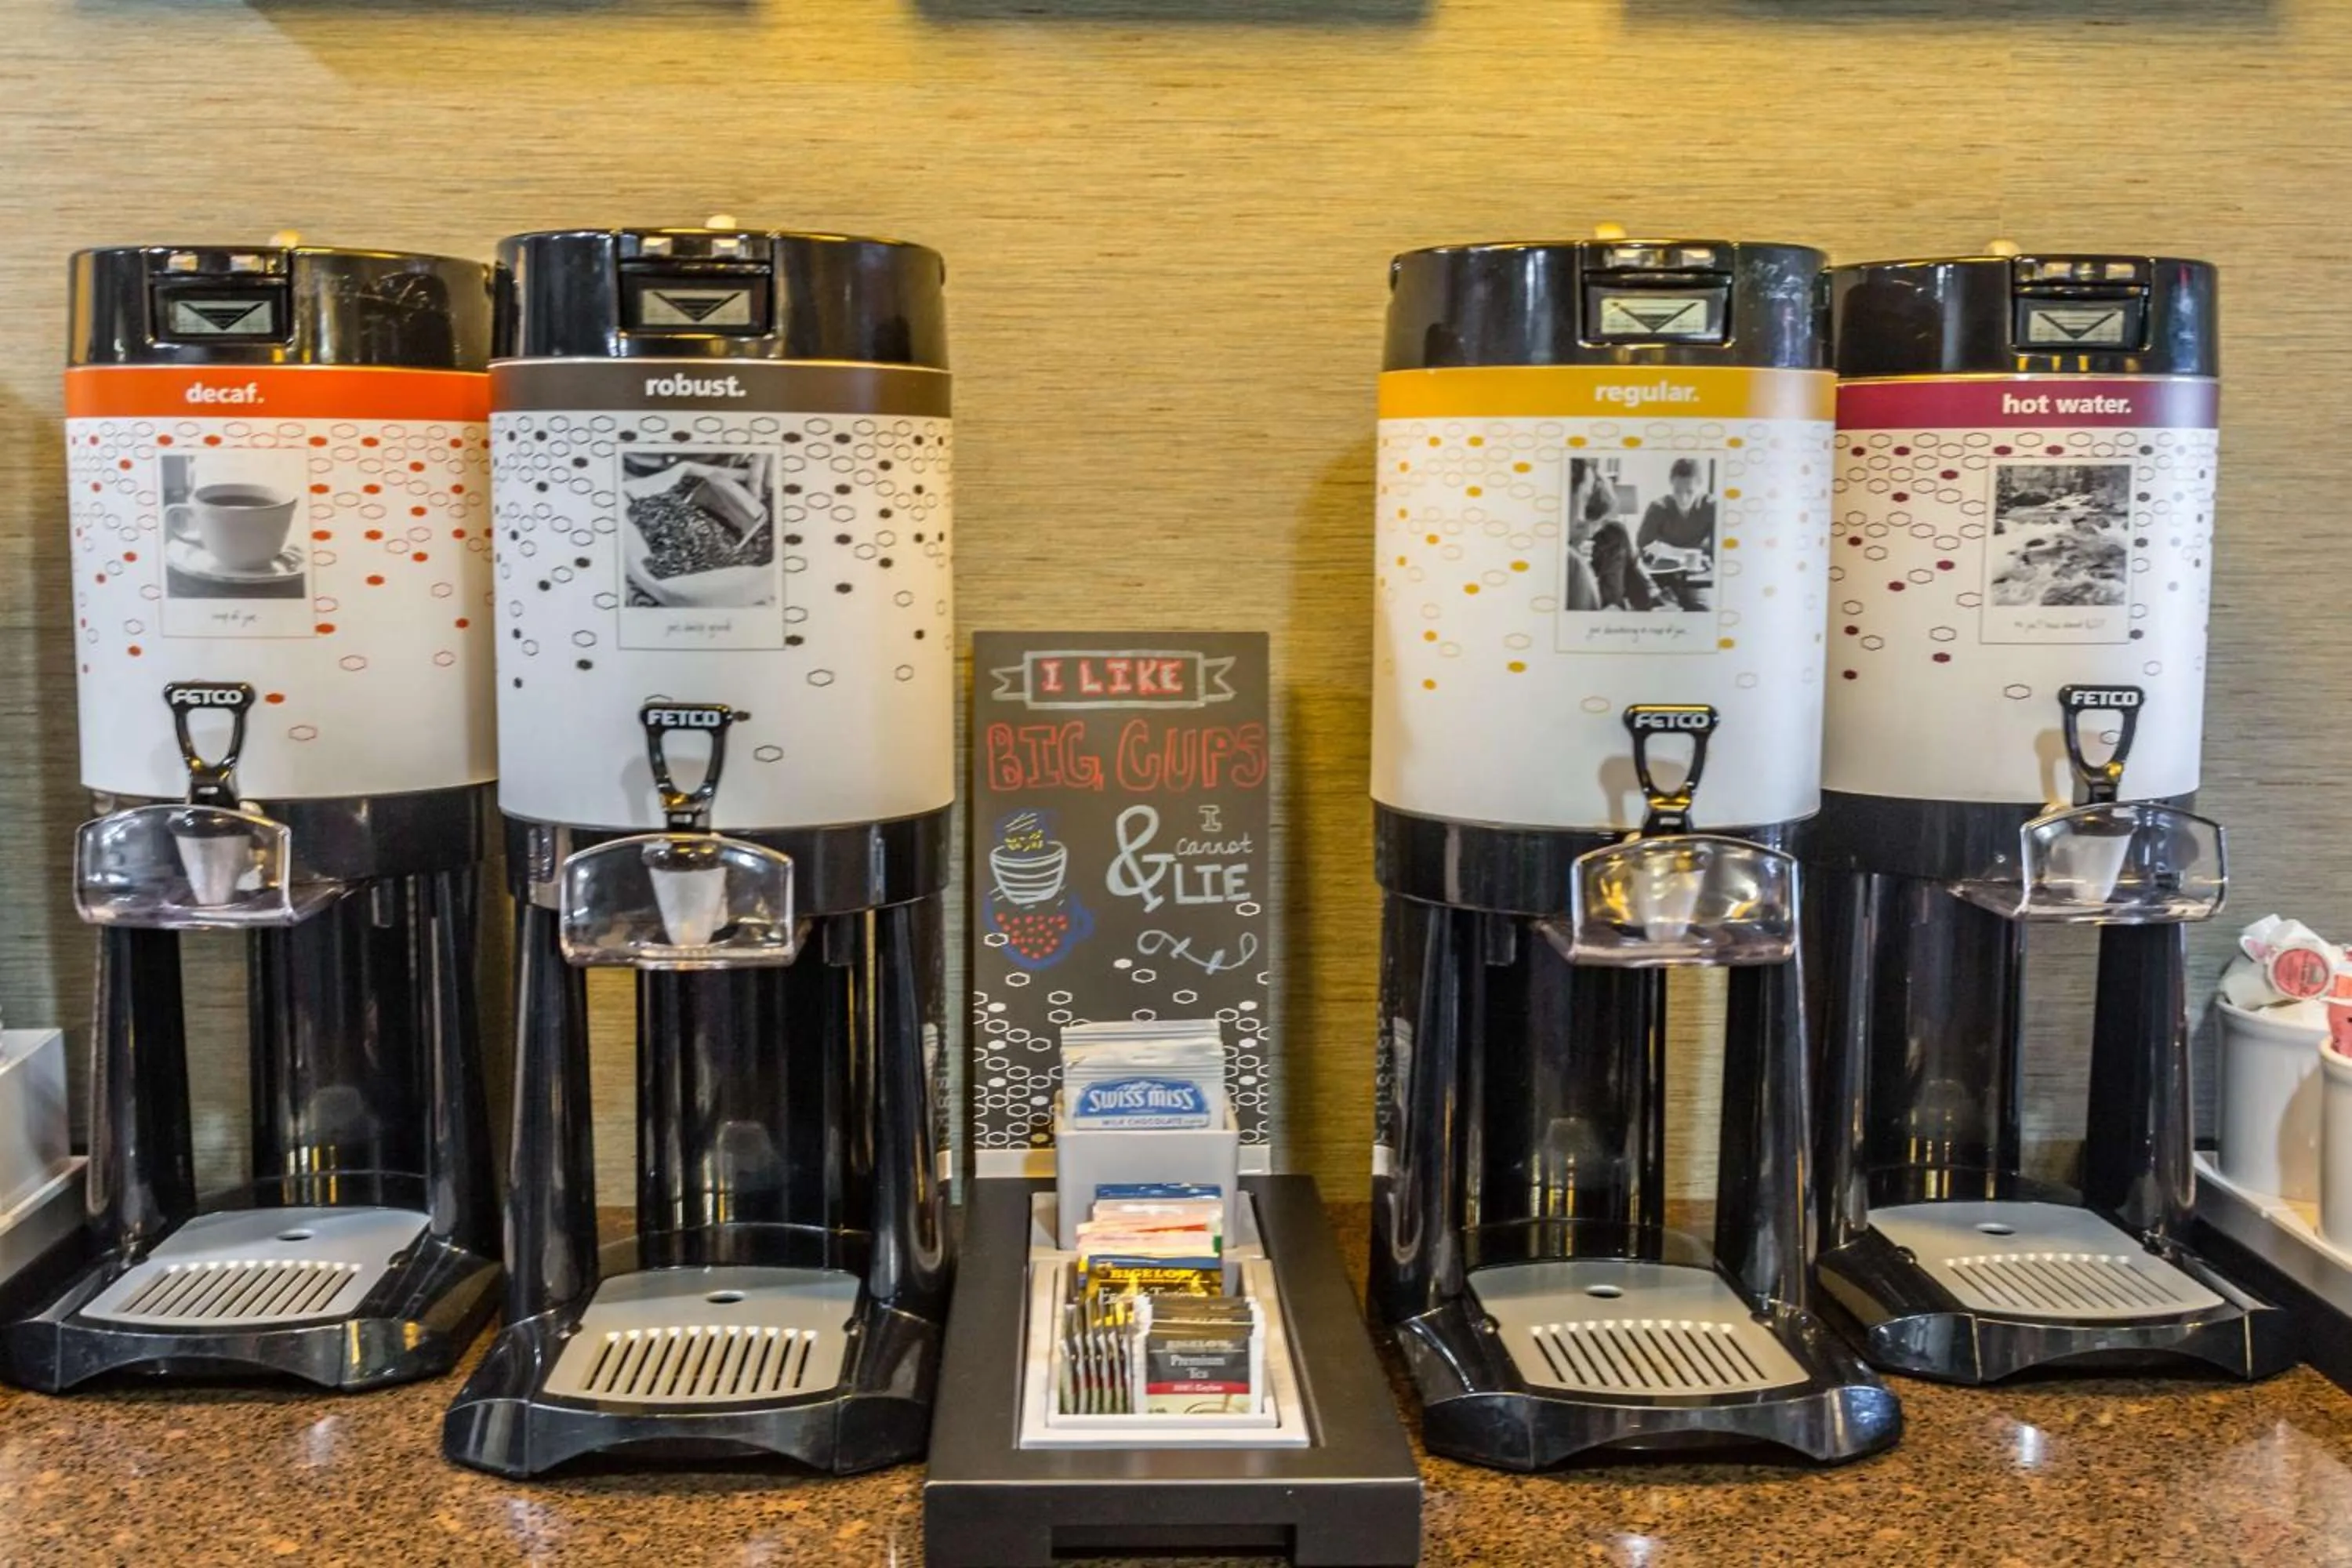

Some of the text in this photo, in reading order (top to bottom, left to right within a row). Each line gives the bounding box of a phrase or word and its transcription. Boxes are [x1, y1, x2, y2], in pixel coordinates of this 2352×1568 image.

[185, 383, 265, 404] decaf.
[644, 373, 747, 397] robust.
[1594, 380, 1700, 406] regular.
[2002, 394, 2132, 415] hot water.
[1040, 658, 1185, 695] I LIKE
[171, 688, 244, 705] FETCO
[2070, 690, 2140, 706] FETCO
[647, 709, 723, 728] FETCO
[1634, 713, 1711, 729] FETCO
[987, 719, 1269, 792] BIG CUPS
[1199, 805, 1223, 833] I
[1176, 863, 1253, 905] LIE
[1088, 1088, 1145, 1112] SWISS
